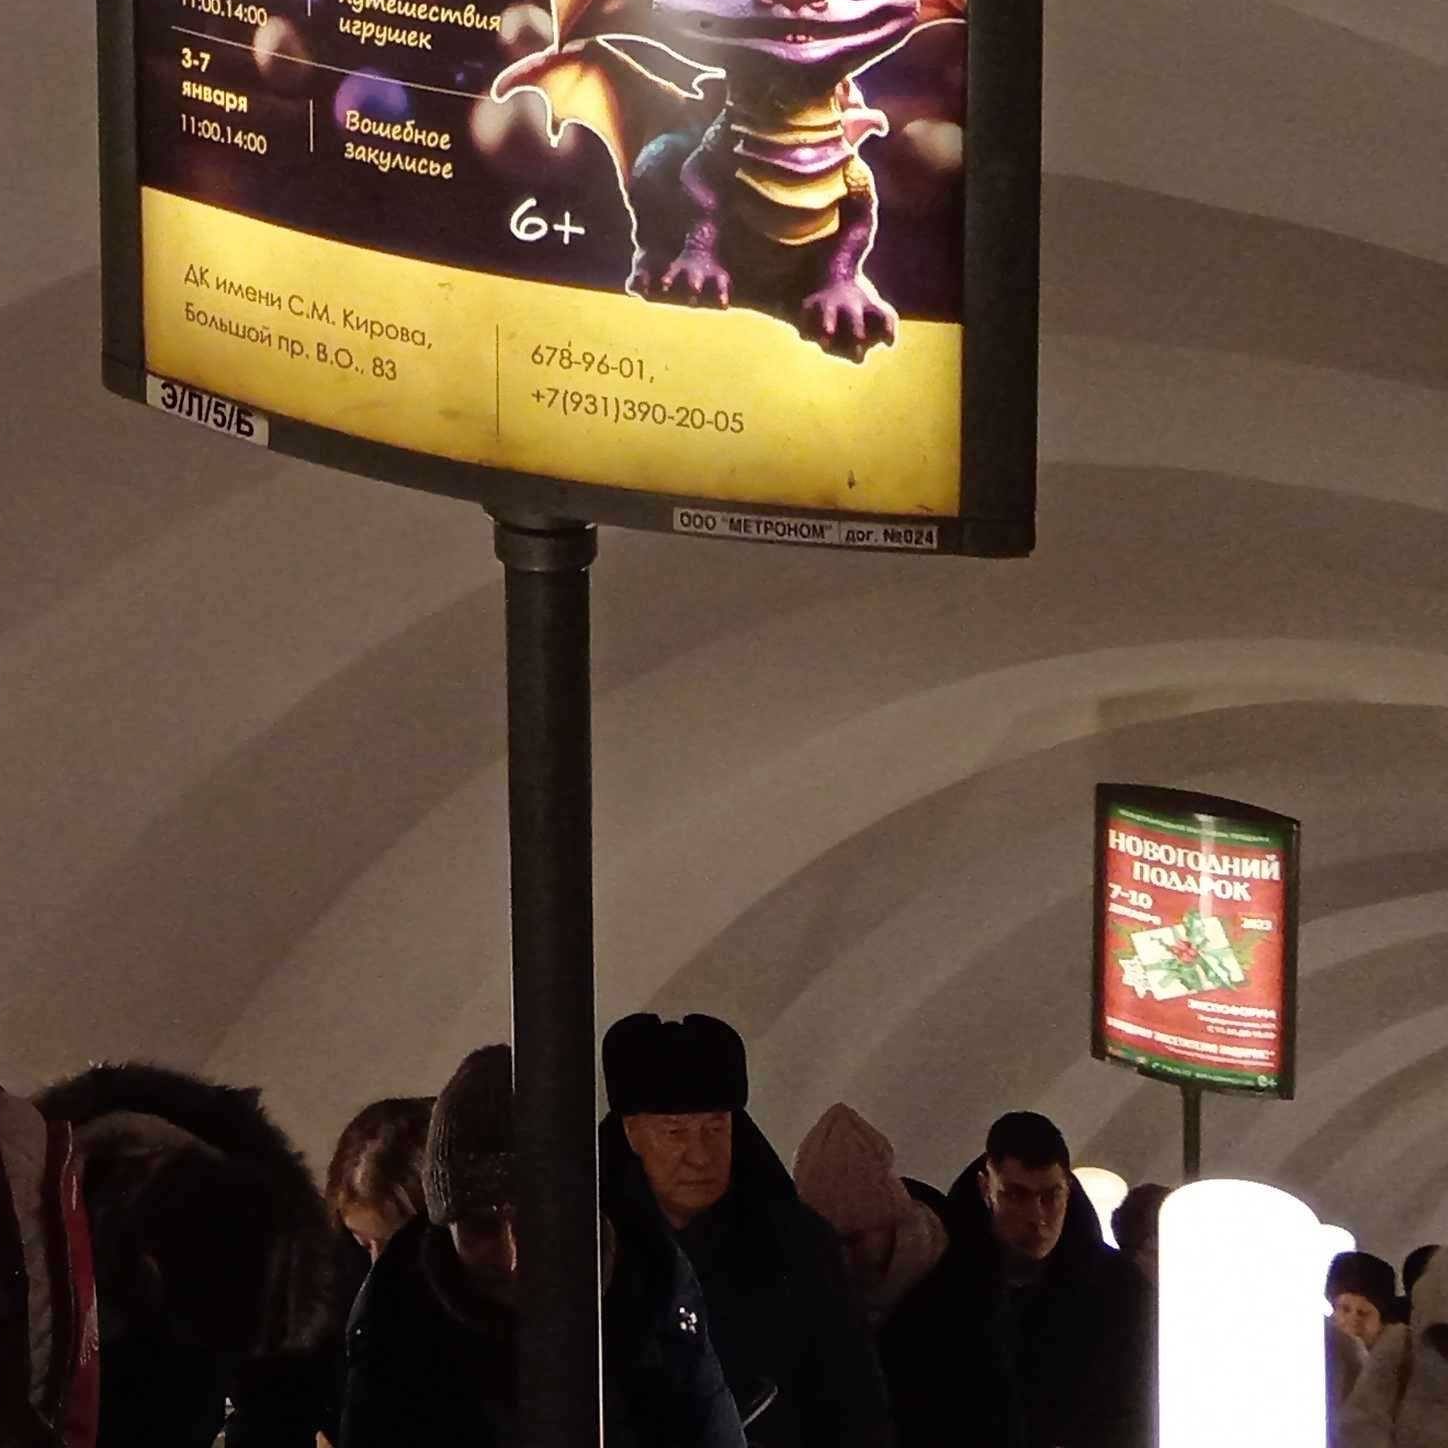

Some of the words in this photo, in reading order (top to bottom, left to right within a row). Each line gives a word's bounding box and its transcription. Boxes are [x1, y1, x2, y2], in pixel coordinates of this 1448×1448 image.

[339, 17, 432, 50] игрушек
[181, 48, 210, 72] 3-7
[182, 80, 248, 113] января
[346, 110, 452, 150] Вошебное
[344, 141, 453, 180] закулисье
[510, 198, 585, 245] 6+
[184, 264, 209, 289] ДК
[216, 275, 282, 310] имени
[288, 294, 336, 326] С.М.
[343, 308, 433, 349] Кирова,
[185, 302, 272, 347] Большой
[278, 334, 309, 360] пр.
[371, 356, 397, 381] 83
[531, 344, 654, 383] 678-96-01,
[531, 388, 744, 433] +7(931)390-20-05
[680, 511, 716, 530] ООО
[883, 528, 933, 545] №024
[1108, 829, 1281, 880] НОВОГОДНИЙ
[1132, 861, 1252, 902] ПОДАРОК
